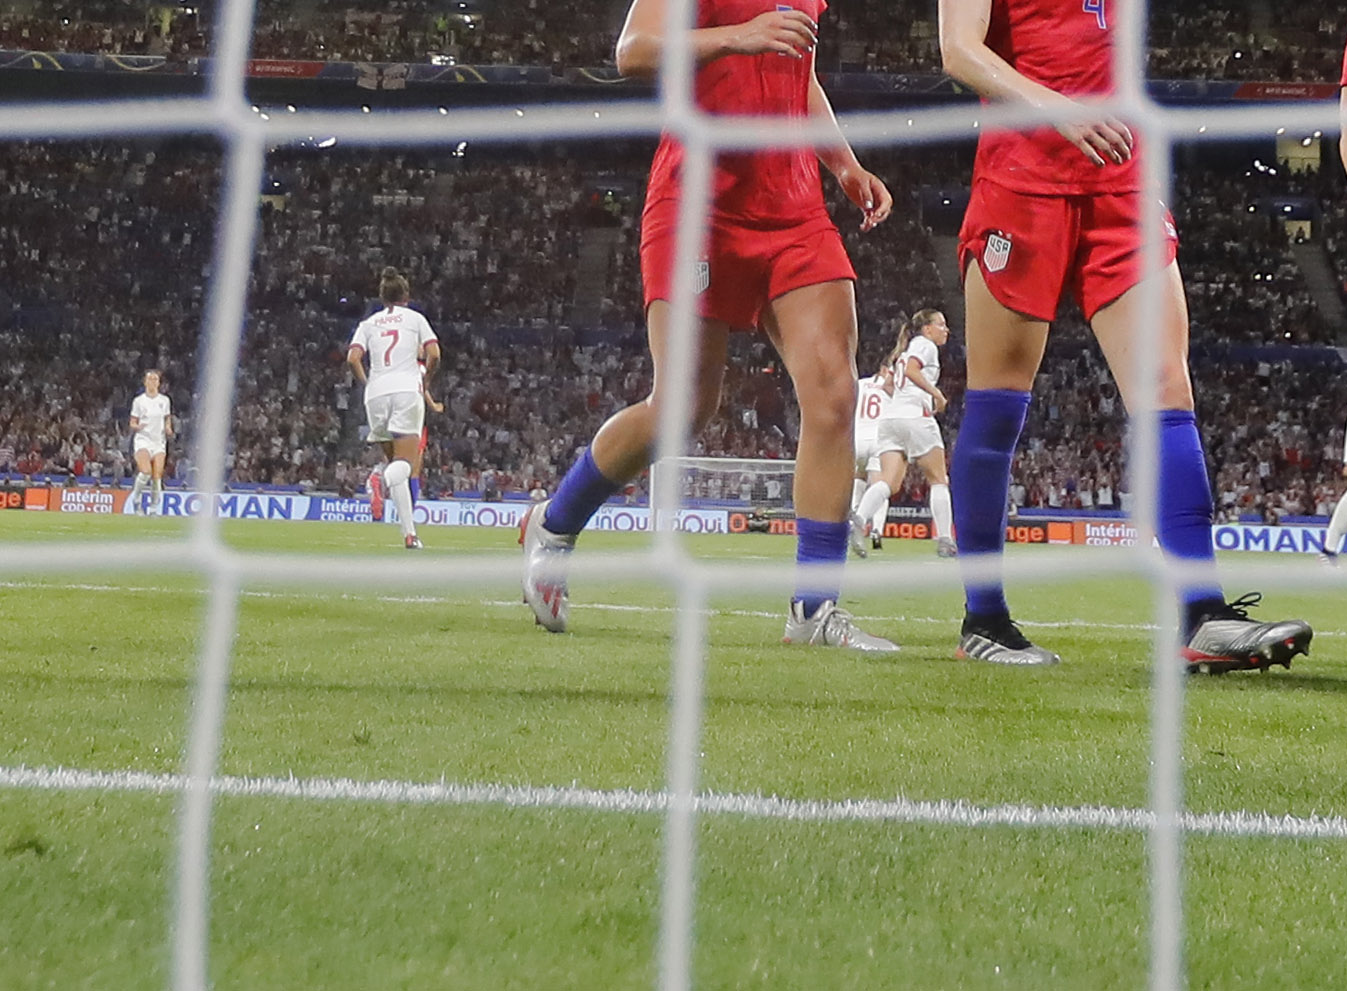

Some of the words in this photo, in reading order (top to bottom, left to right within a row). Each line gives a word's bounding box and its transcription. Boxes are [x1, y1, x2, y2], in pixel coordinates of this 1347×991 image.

[989, 238, 1009, 254] USA
[380, 330, 399, 367] 7
[859, 393, 882, 420] 16
[61, 489, 114, 505] Intérim
[1215, 526, 1329, 554] OMAN
